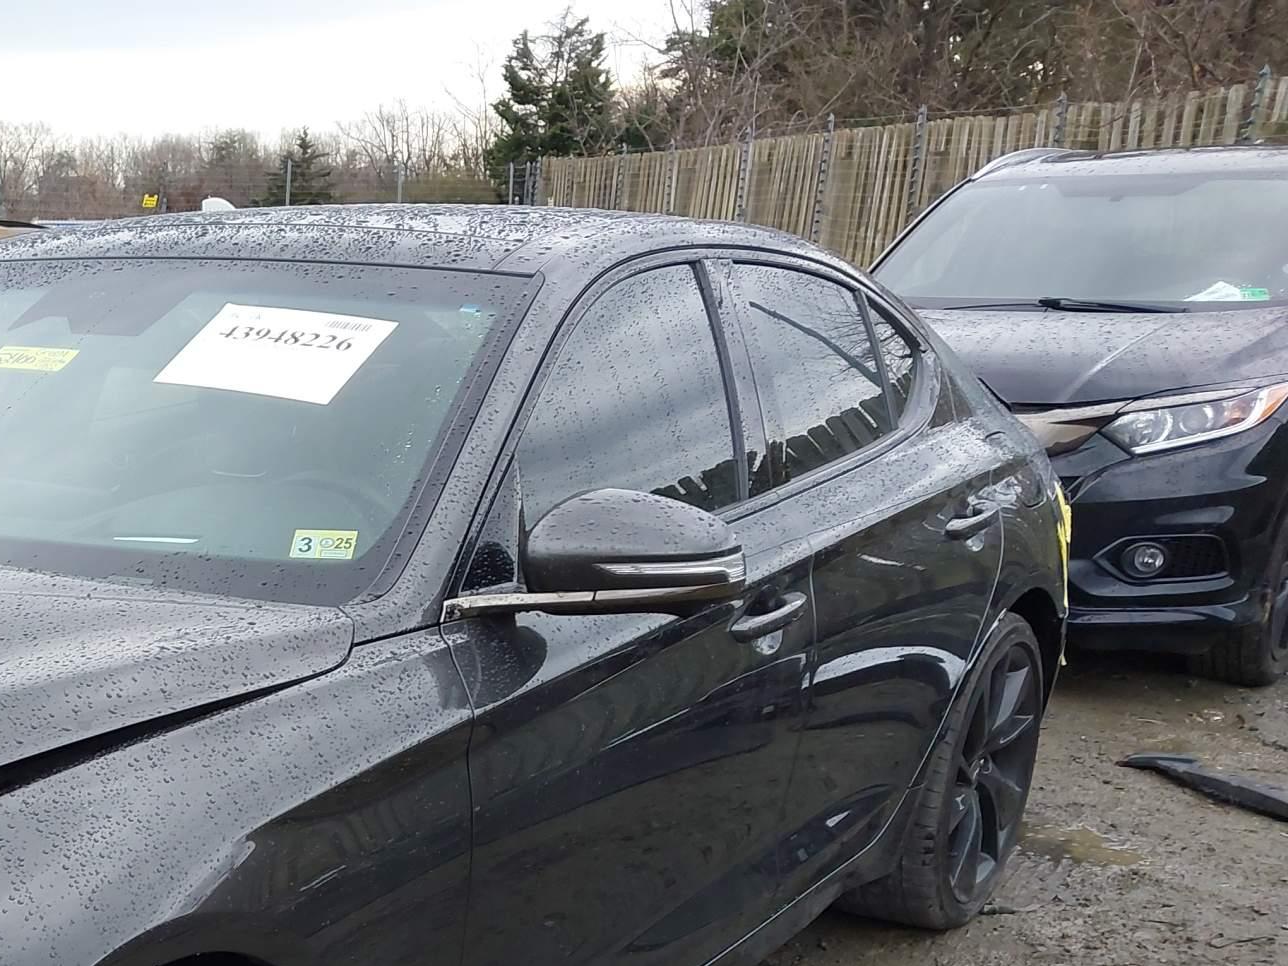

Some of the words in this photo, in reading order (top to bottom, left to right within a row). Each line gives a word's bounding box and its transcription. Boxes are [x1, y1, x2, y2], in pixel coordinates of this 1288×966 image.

[219, 325, 353, 352] 43948226
[298, 536, 313, 553] 3
[334, 537, 353, 550] 25
